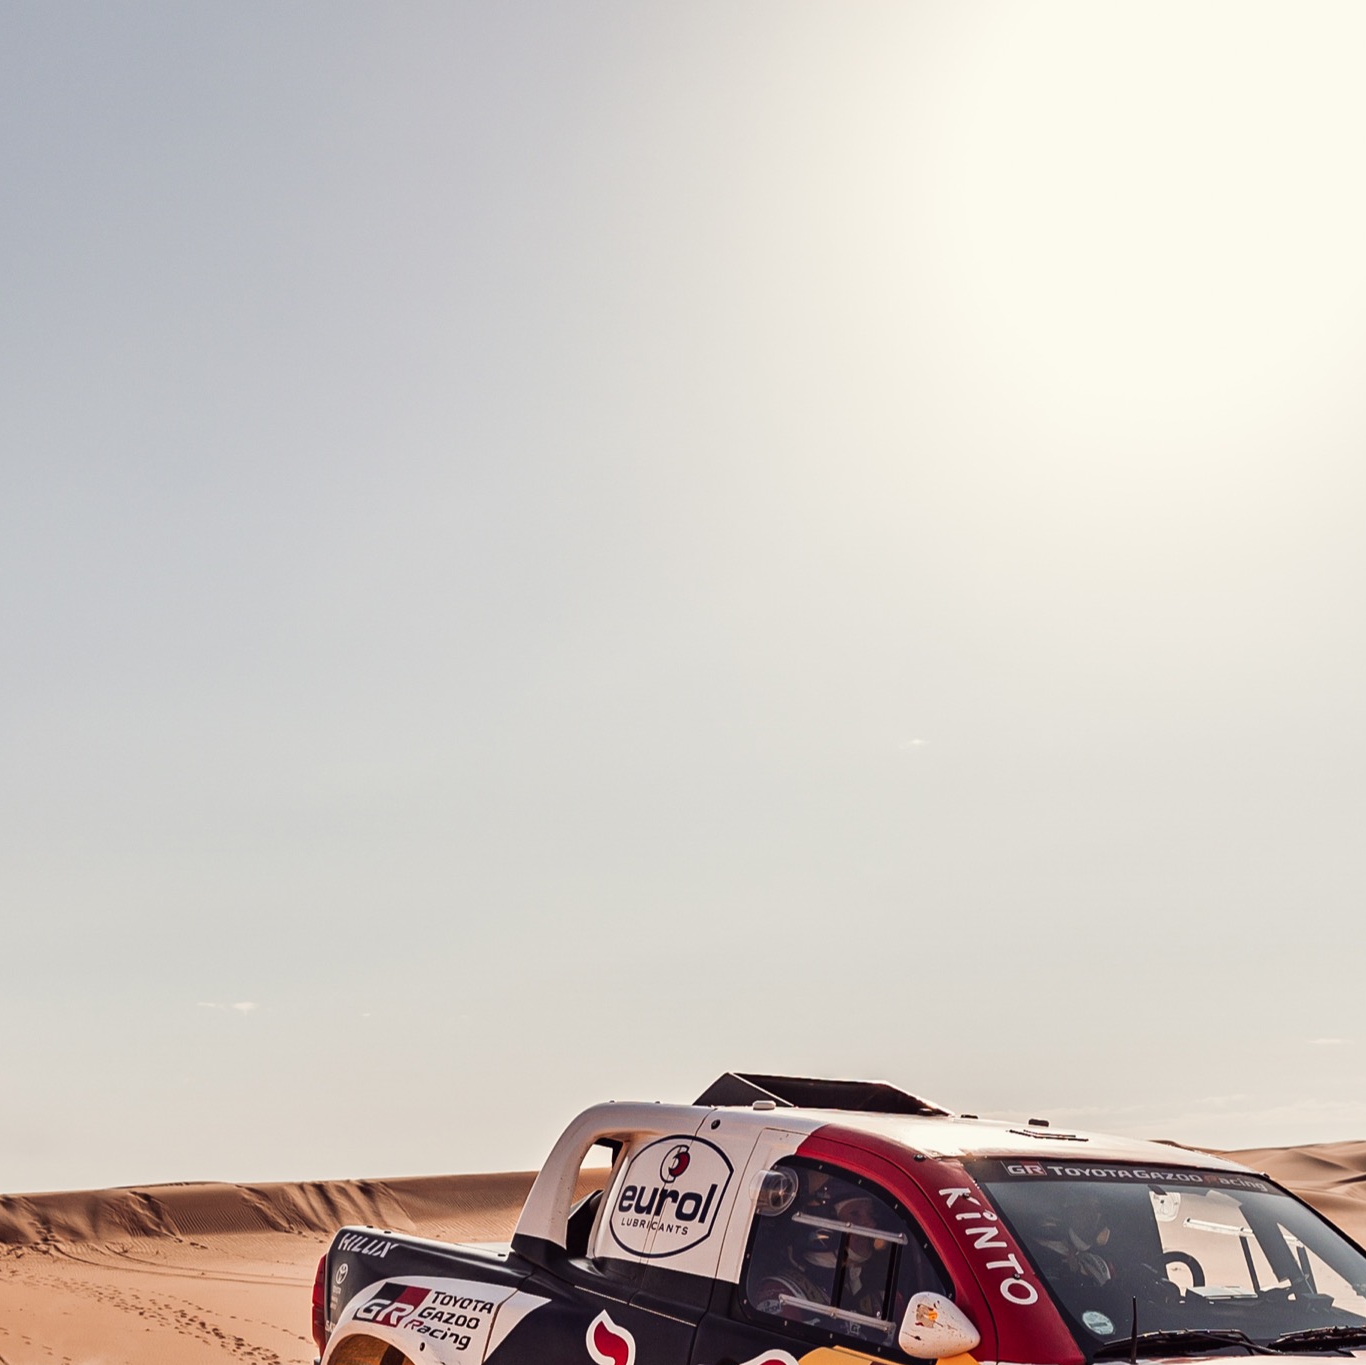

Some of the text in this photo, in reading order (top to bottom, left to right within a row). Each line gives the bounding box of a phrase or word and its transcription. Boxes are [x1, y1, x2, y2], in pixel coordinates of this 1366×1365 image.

[1007, 1162, 1044, 1176] GR
[1046, 1165, 1131, 1180] TOYOTA
[1133, 1168, 1203, 1183] GAZOO
[618, 1183, 718, 1224] eurol
[620, 1217, 689, 1236] LUBRICANTS
[356, 1298, 414, 1327] GR
[432, 1291, 495, 1315] TOYOTA
[418, 1306, 481, 1330] GAZOO
[403, 1318, 472, 1351] Racing
